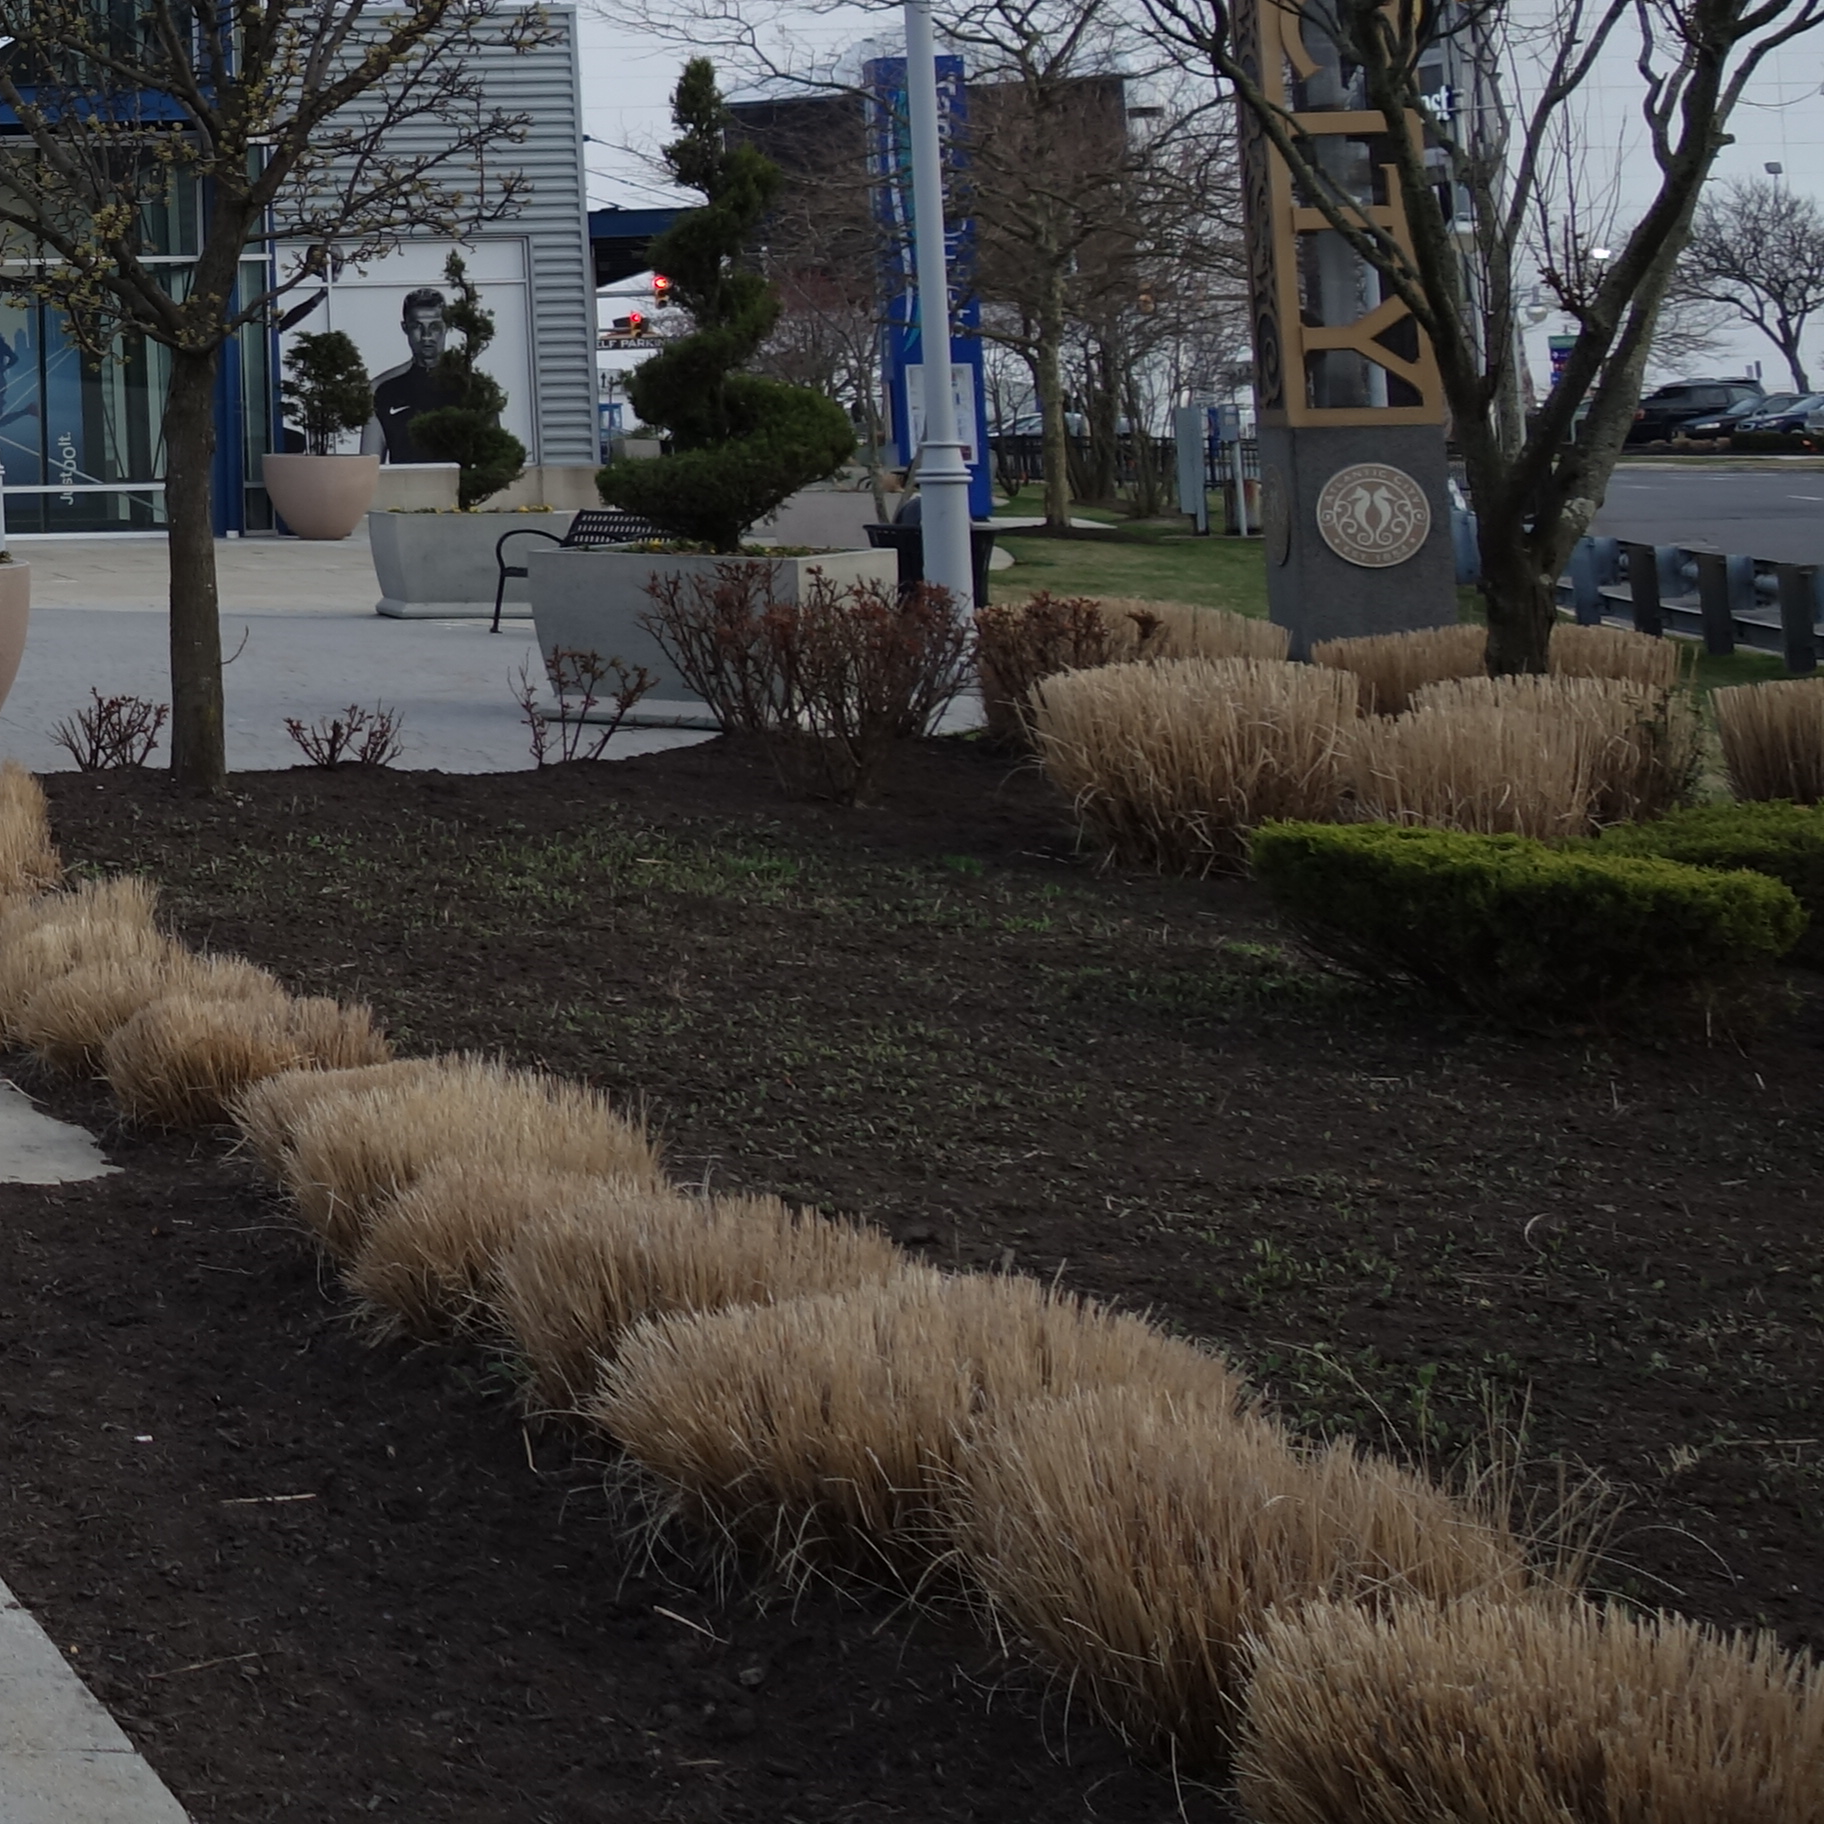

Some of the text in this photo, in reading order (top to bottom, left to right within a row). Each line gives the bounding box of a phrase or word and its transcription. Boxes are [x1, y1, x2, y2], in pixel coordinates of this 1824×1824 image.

[596, 338, 665, 349] ELF PARKIN
[1324, 468, 1421, 504] ATLANTIC CITY
